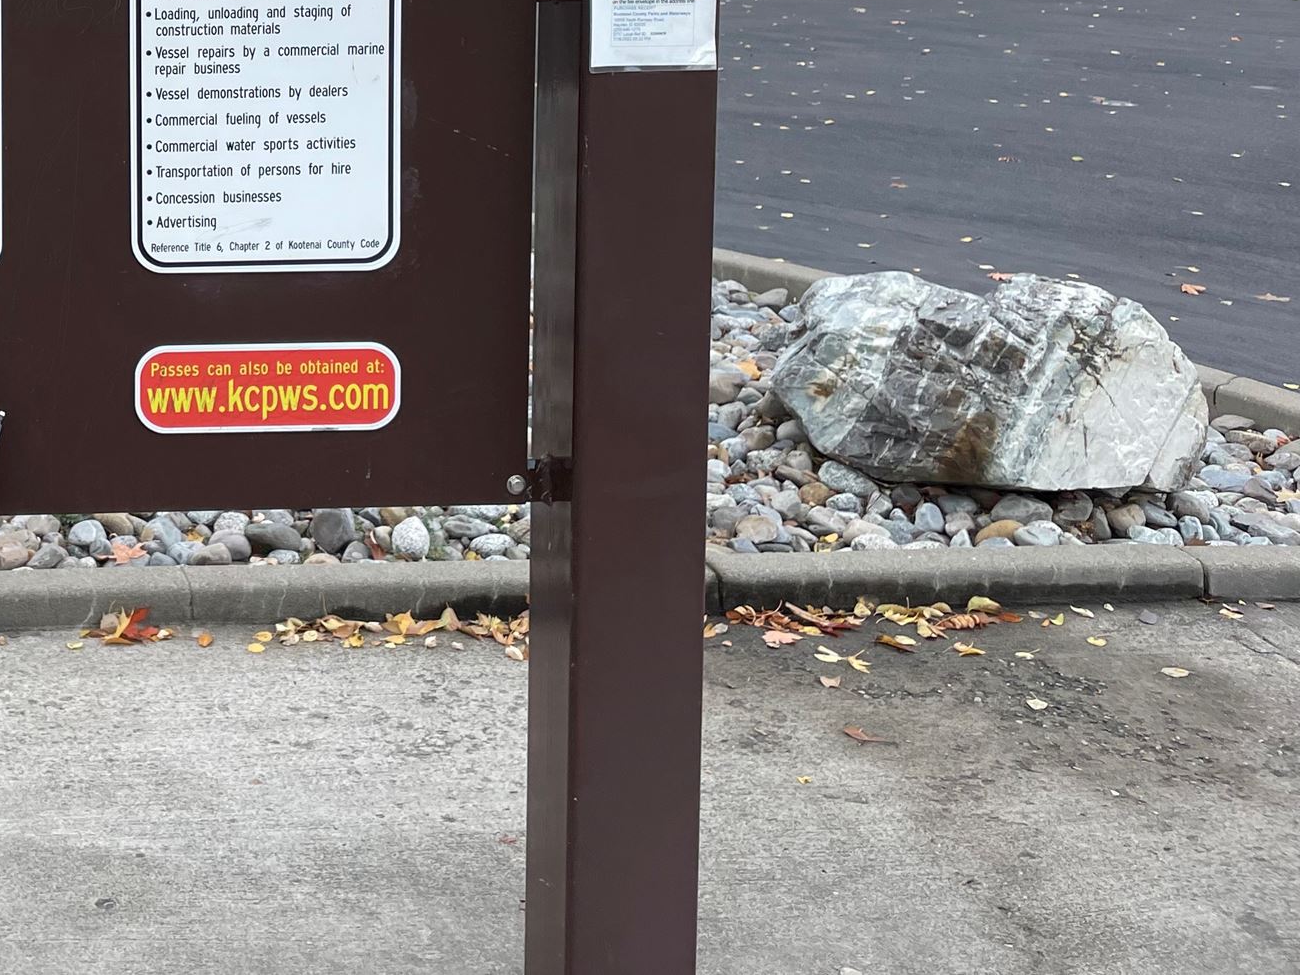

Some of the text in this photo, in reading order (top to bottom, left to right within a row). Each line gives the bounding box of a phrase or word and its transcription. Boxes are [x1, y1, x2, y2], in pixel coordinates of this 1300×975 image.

[154, 3, 352, 23] Loading, unloading and staging of
[155, 161, 352, 181] Transportation of persons for hire
[155, 214, 217, 232] Advertising
[150, 359, 385, 377] Passes can also be obtained at:
[146, 378, 389, 421] www.kcpws.com
